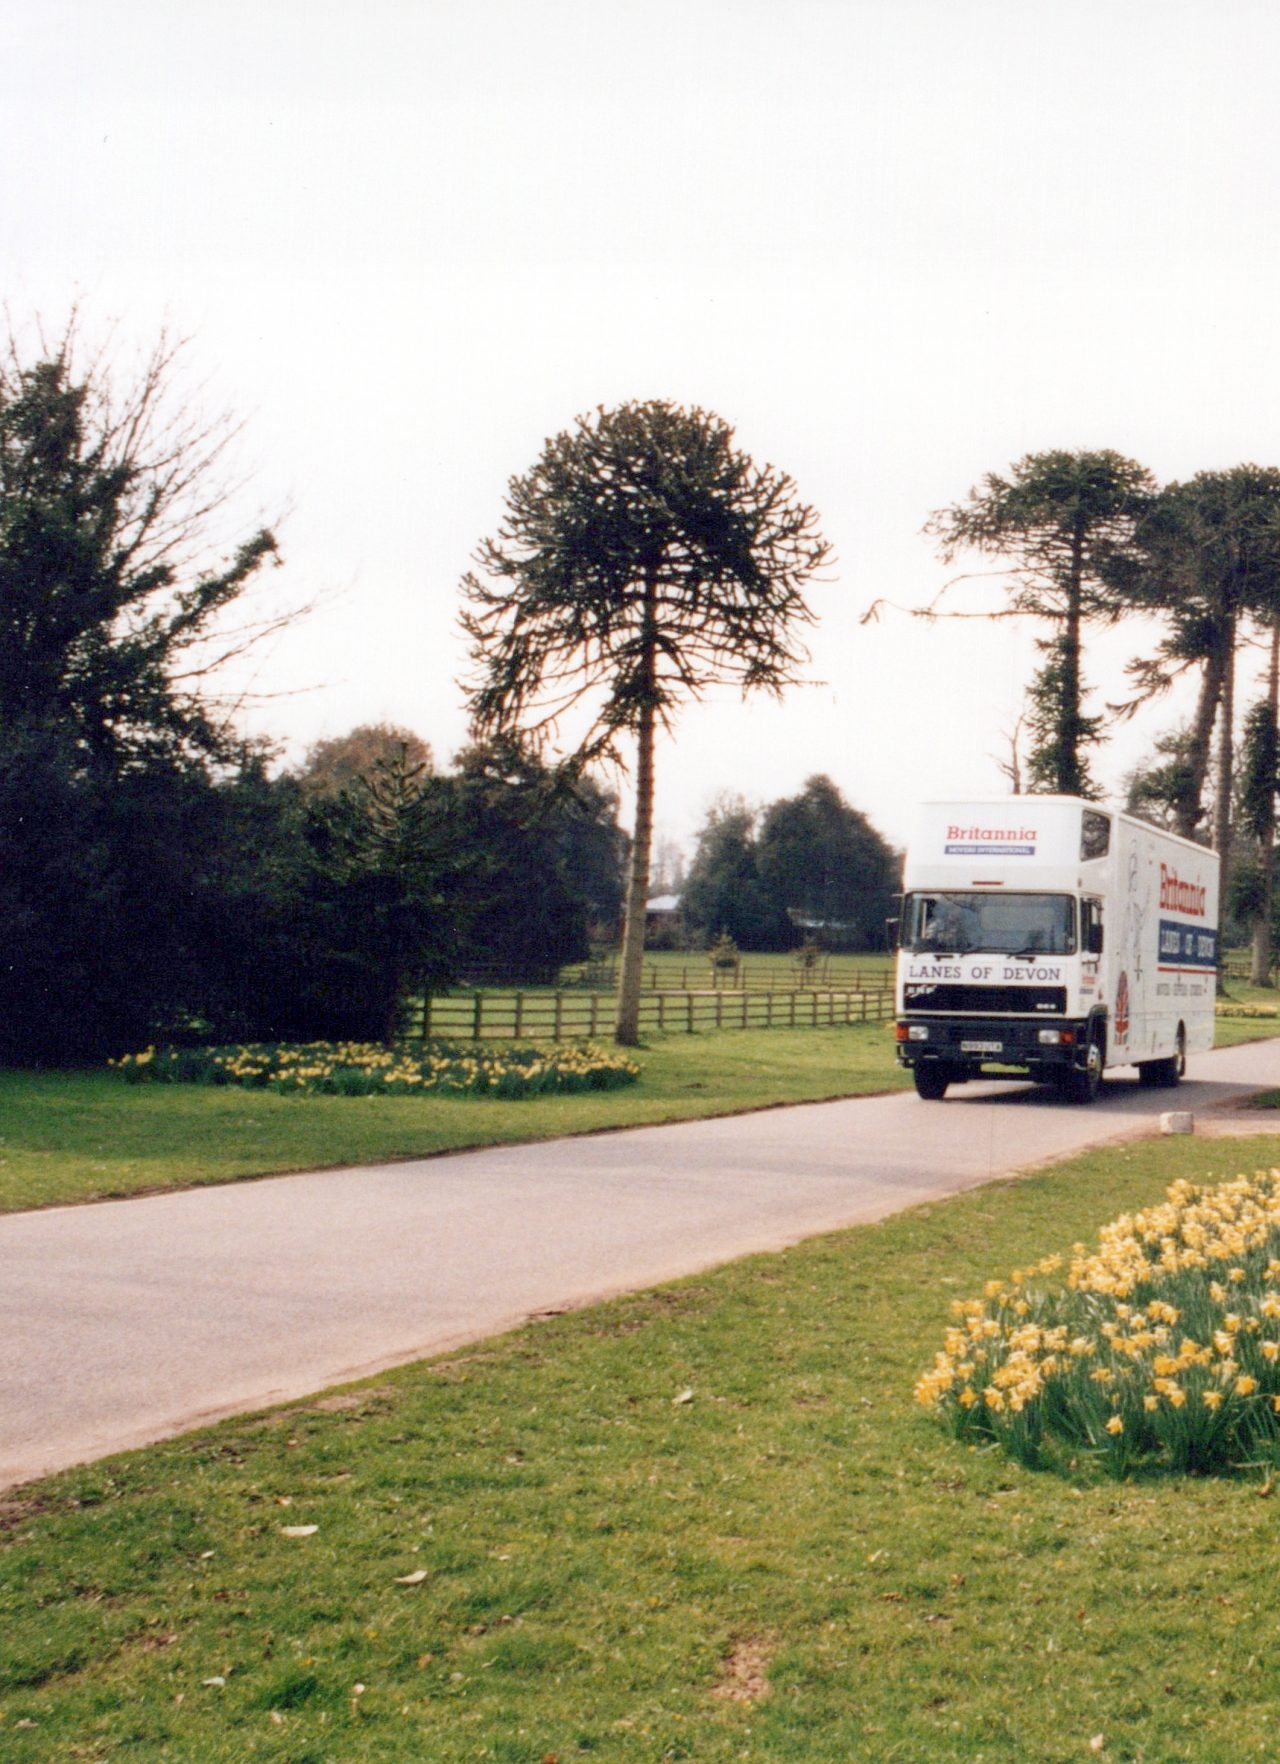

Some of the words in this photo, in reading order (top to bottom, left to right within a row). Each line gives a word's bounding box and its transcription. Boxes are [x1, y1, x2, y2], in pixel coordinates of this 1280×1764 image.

[946, 825, 1038, 841] Britannia
[1159, 863, 1206, 916] Britannia
[909, 965, 961, 979] LANES
[971, 967, 993, 980] OF
[1003, 968, 1061, 981] DEVON
